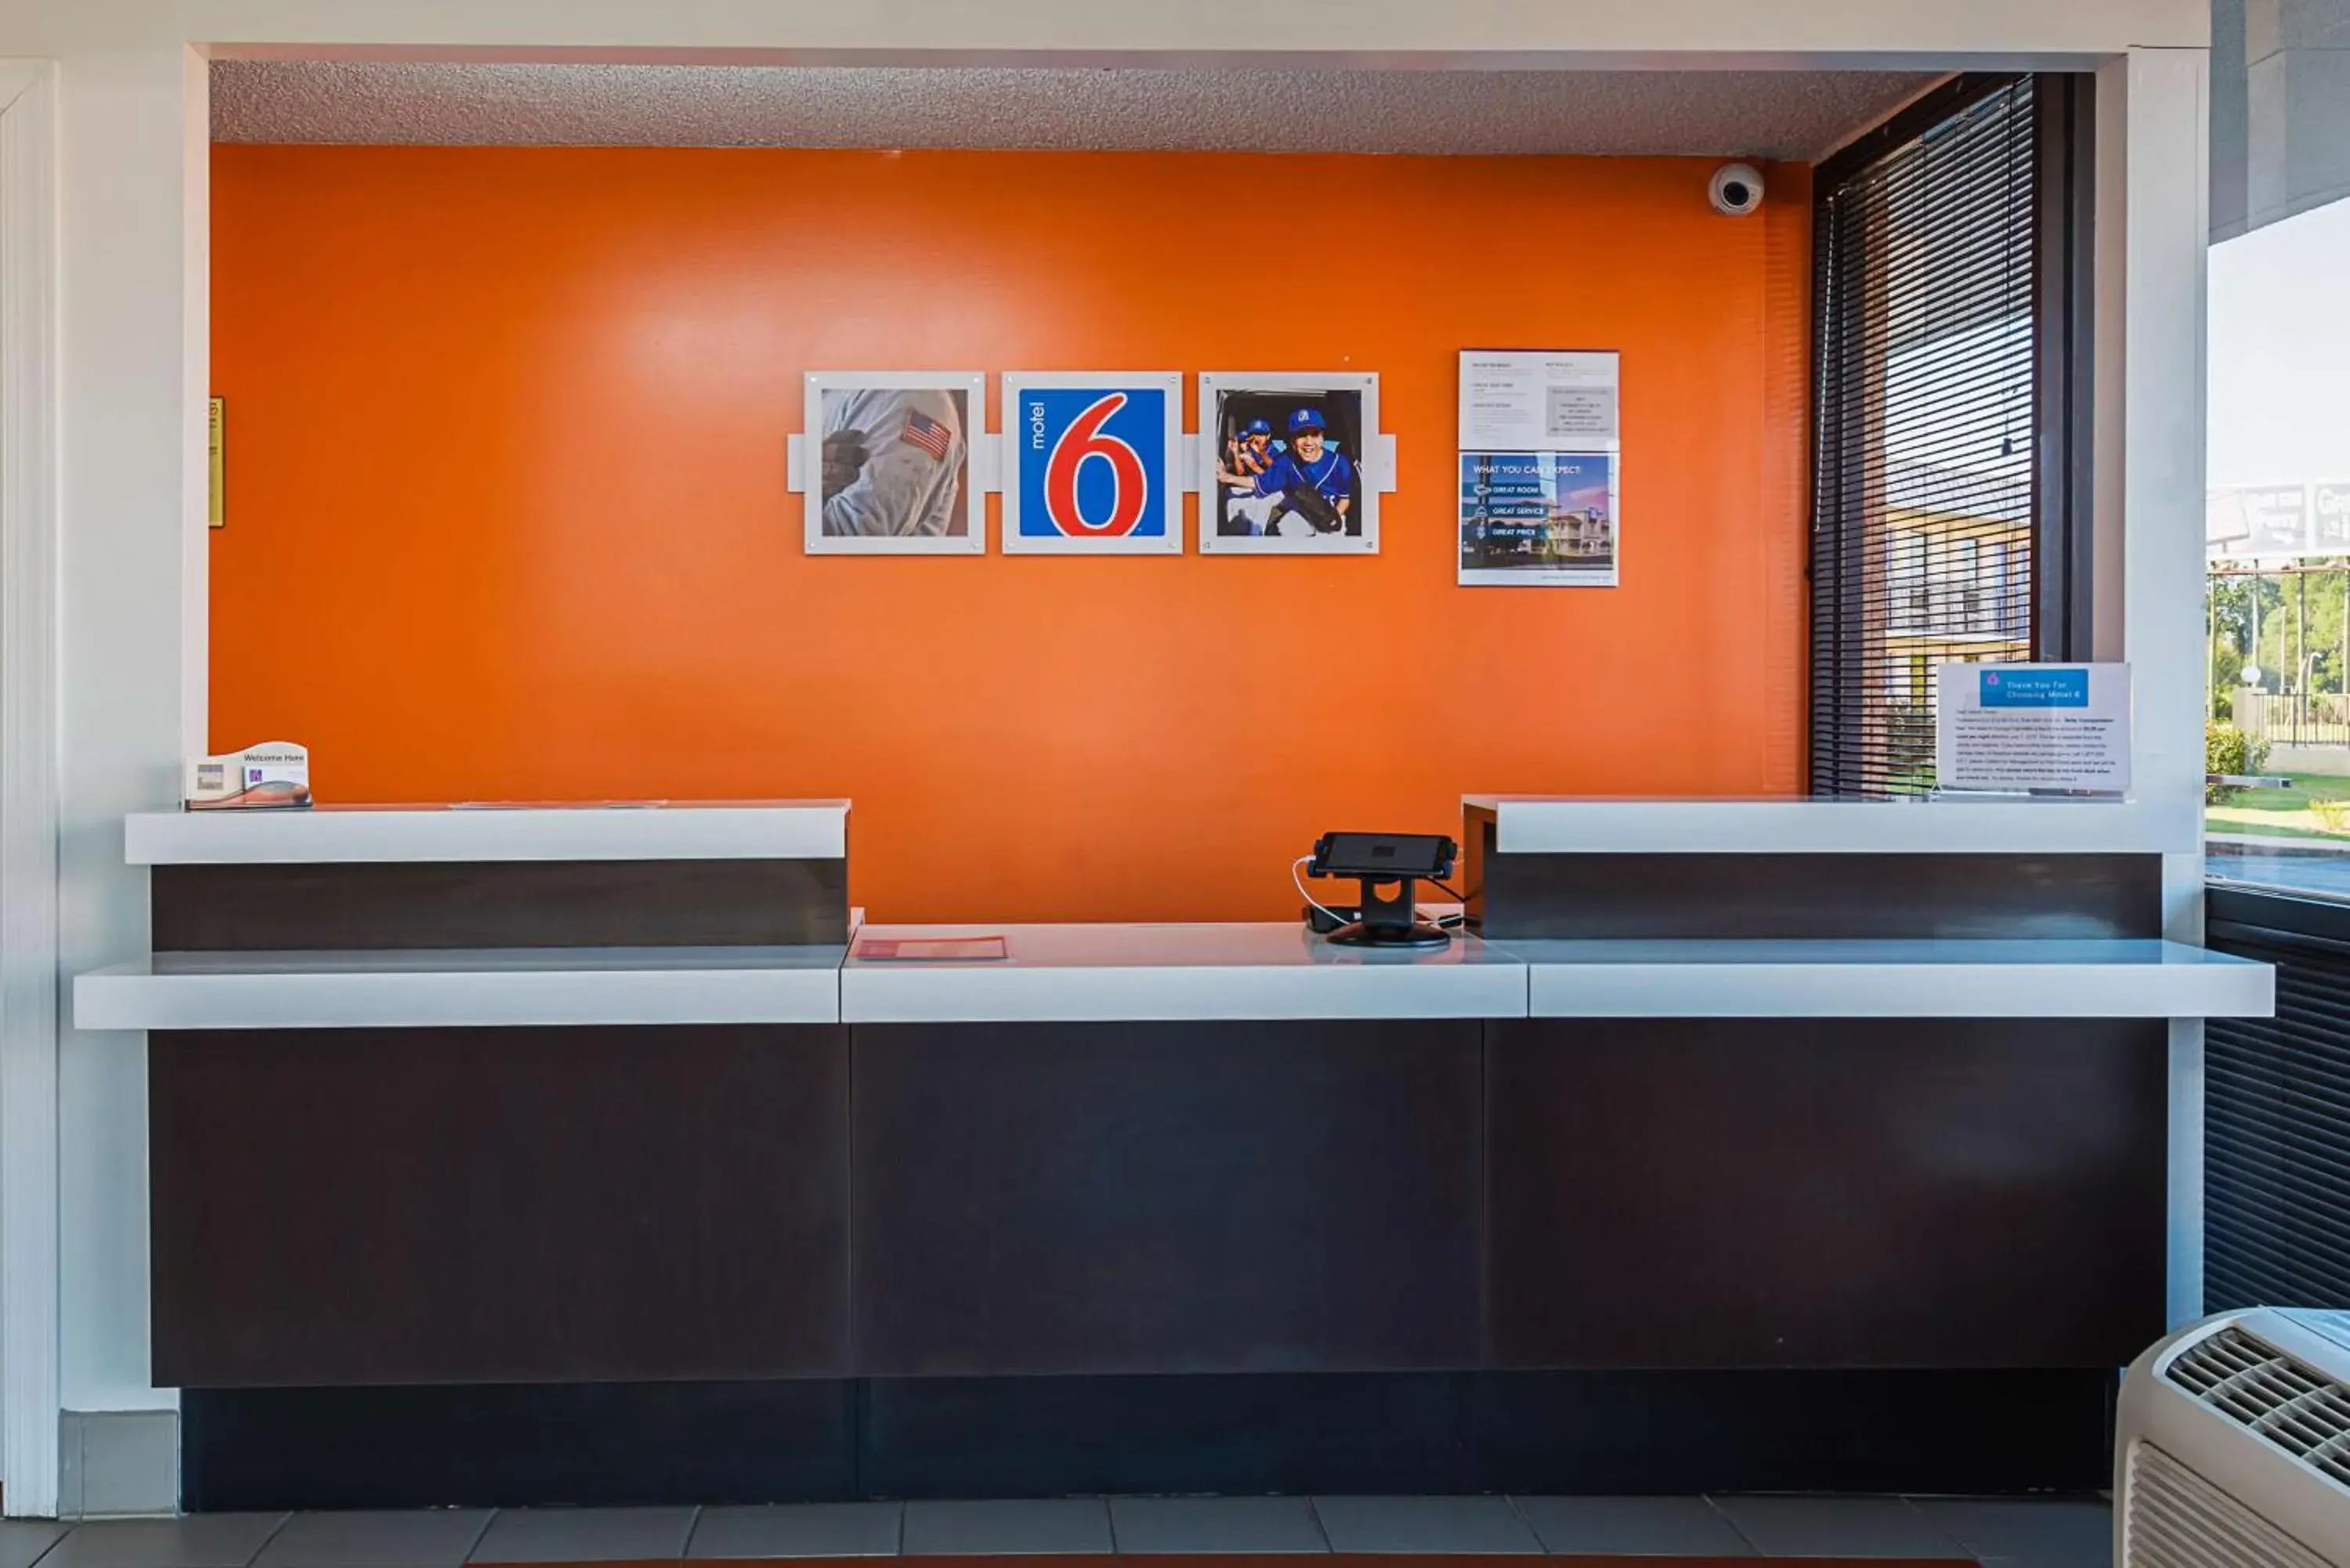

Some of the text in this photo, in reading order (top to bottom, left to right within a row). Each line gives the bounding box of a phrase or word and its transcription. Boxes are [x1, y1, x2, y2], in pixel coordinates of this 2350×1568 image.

[1029, 402, 1046, 449] motel
[1045, 392, 1148, 537] 6
[2006, 690, 2044, 699] Choosing
